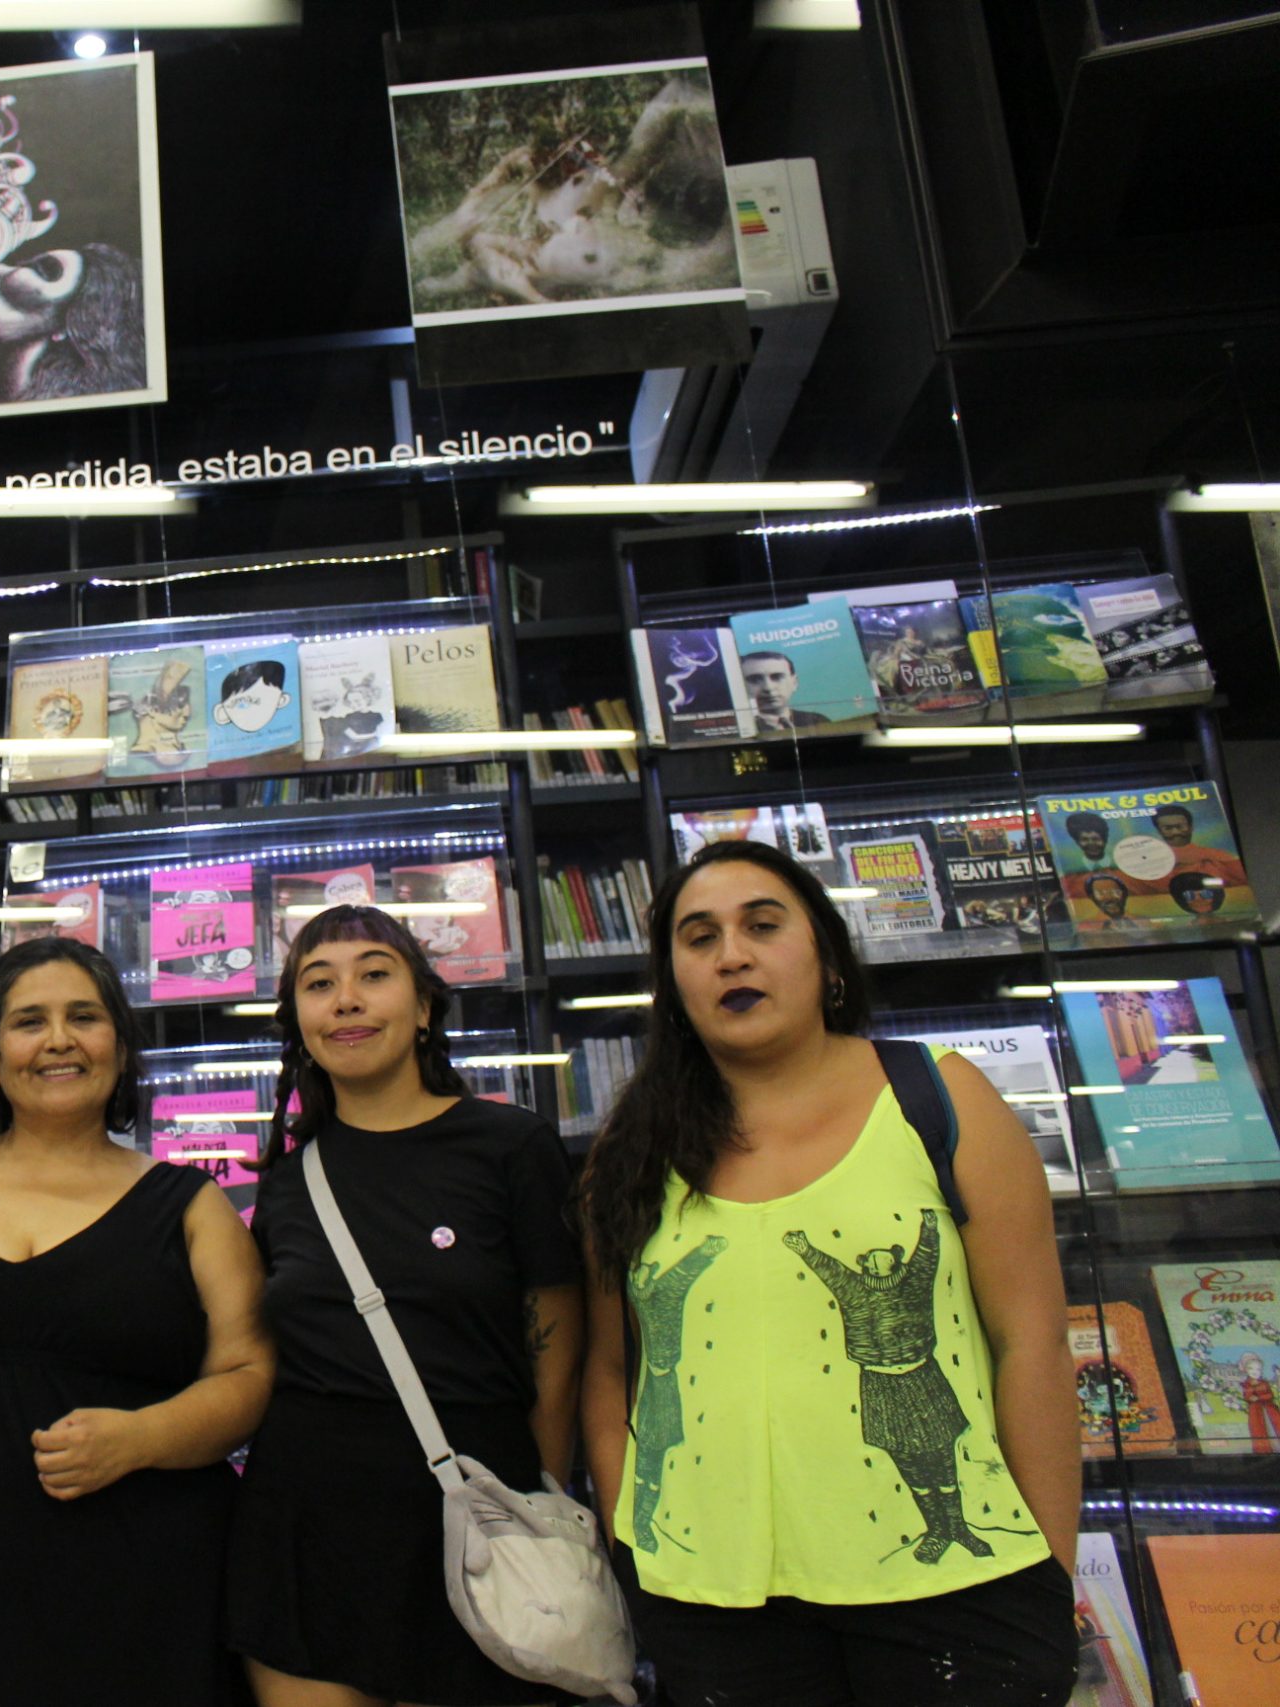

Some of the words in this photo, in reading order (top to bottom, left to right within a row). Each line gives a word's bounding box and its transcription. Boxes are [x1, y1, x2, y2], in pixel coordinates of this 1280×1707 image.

[178, 445, 313, 485] estaba
[326, 444, 376, 473] en
[389, 434, 425, 467] el
[748, 619, 839, 645] HUIDOBRO
[404, 639, 477, 666] Pelos
[899, 661, 953, 678] Reina
[902, 669, 974, 688] Victoria
[1046, 796, 1116, 814] FUNK
[1118, 795, 1139, 809] &
[1143, 787, 1208, 806] SOUL
[1101, 807, 1159, 820] COVERS
[853, 843, 915, 857] CANCIONES
[858, 862, 922, 881] MUNDO
[948, 860, 1000, 882] HEAVY
[1000, 855, 1054, 879] METAL
[176, 921, 226, 948] JEFA
[1180, 1266, 1275, 1313] Emma
[1189, 1600, 1236, 1615] Pasión
[1240, 1602, 1264, 1616] por
